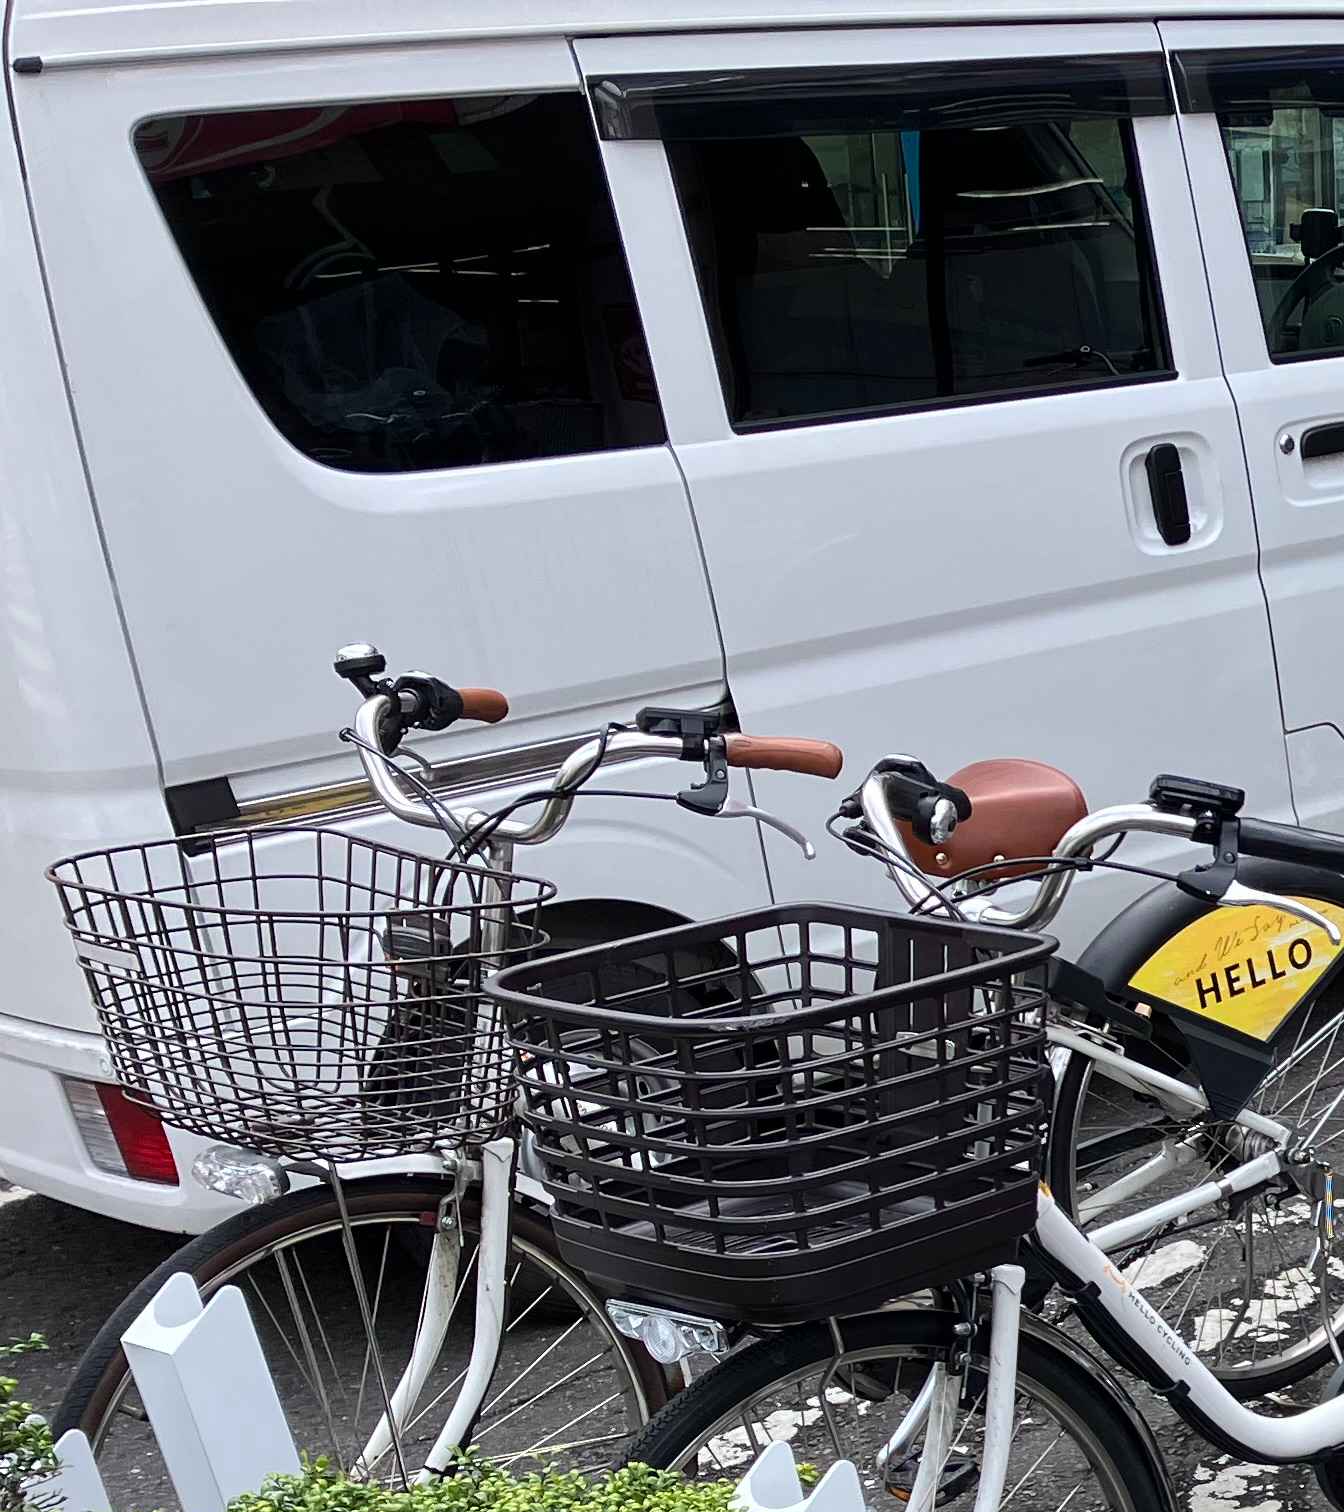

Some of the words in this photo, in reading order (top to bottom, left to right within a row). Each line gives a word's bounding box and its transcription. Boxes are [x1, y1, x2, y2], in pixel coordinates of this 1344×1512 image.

[1195, 937, 1313, 1010] HELLO
[1128, 1291, 1156, 1325] HELLO
[1156, 1325, 1191, 1366] CYCLING
